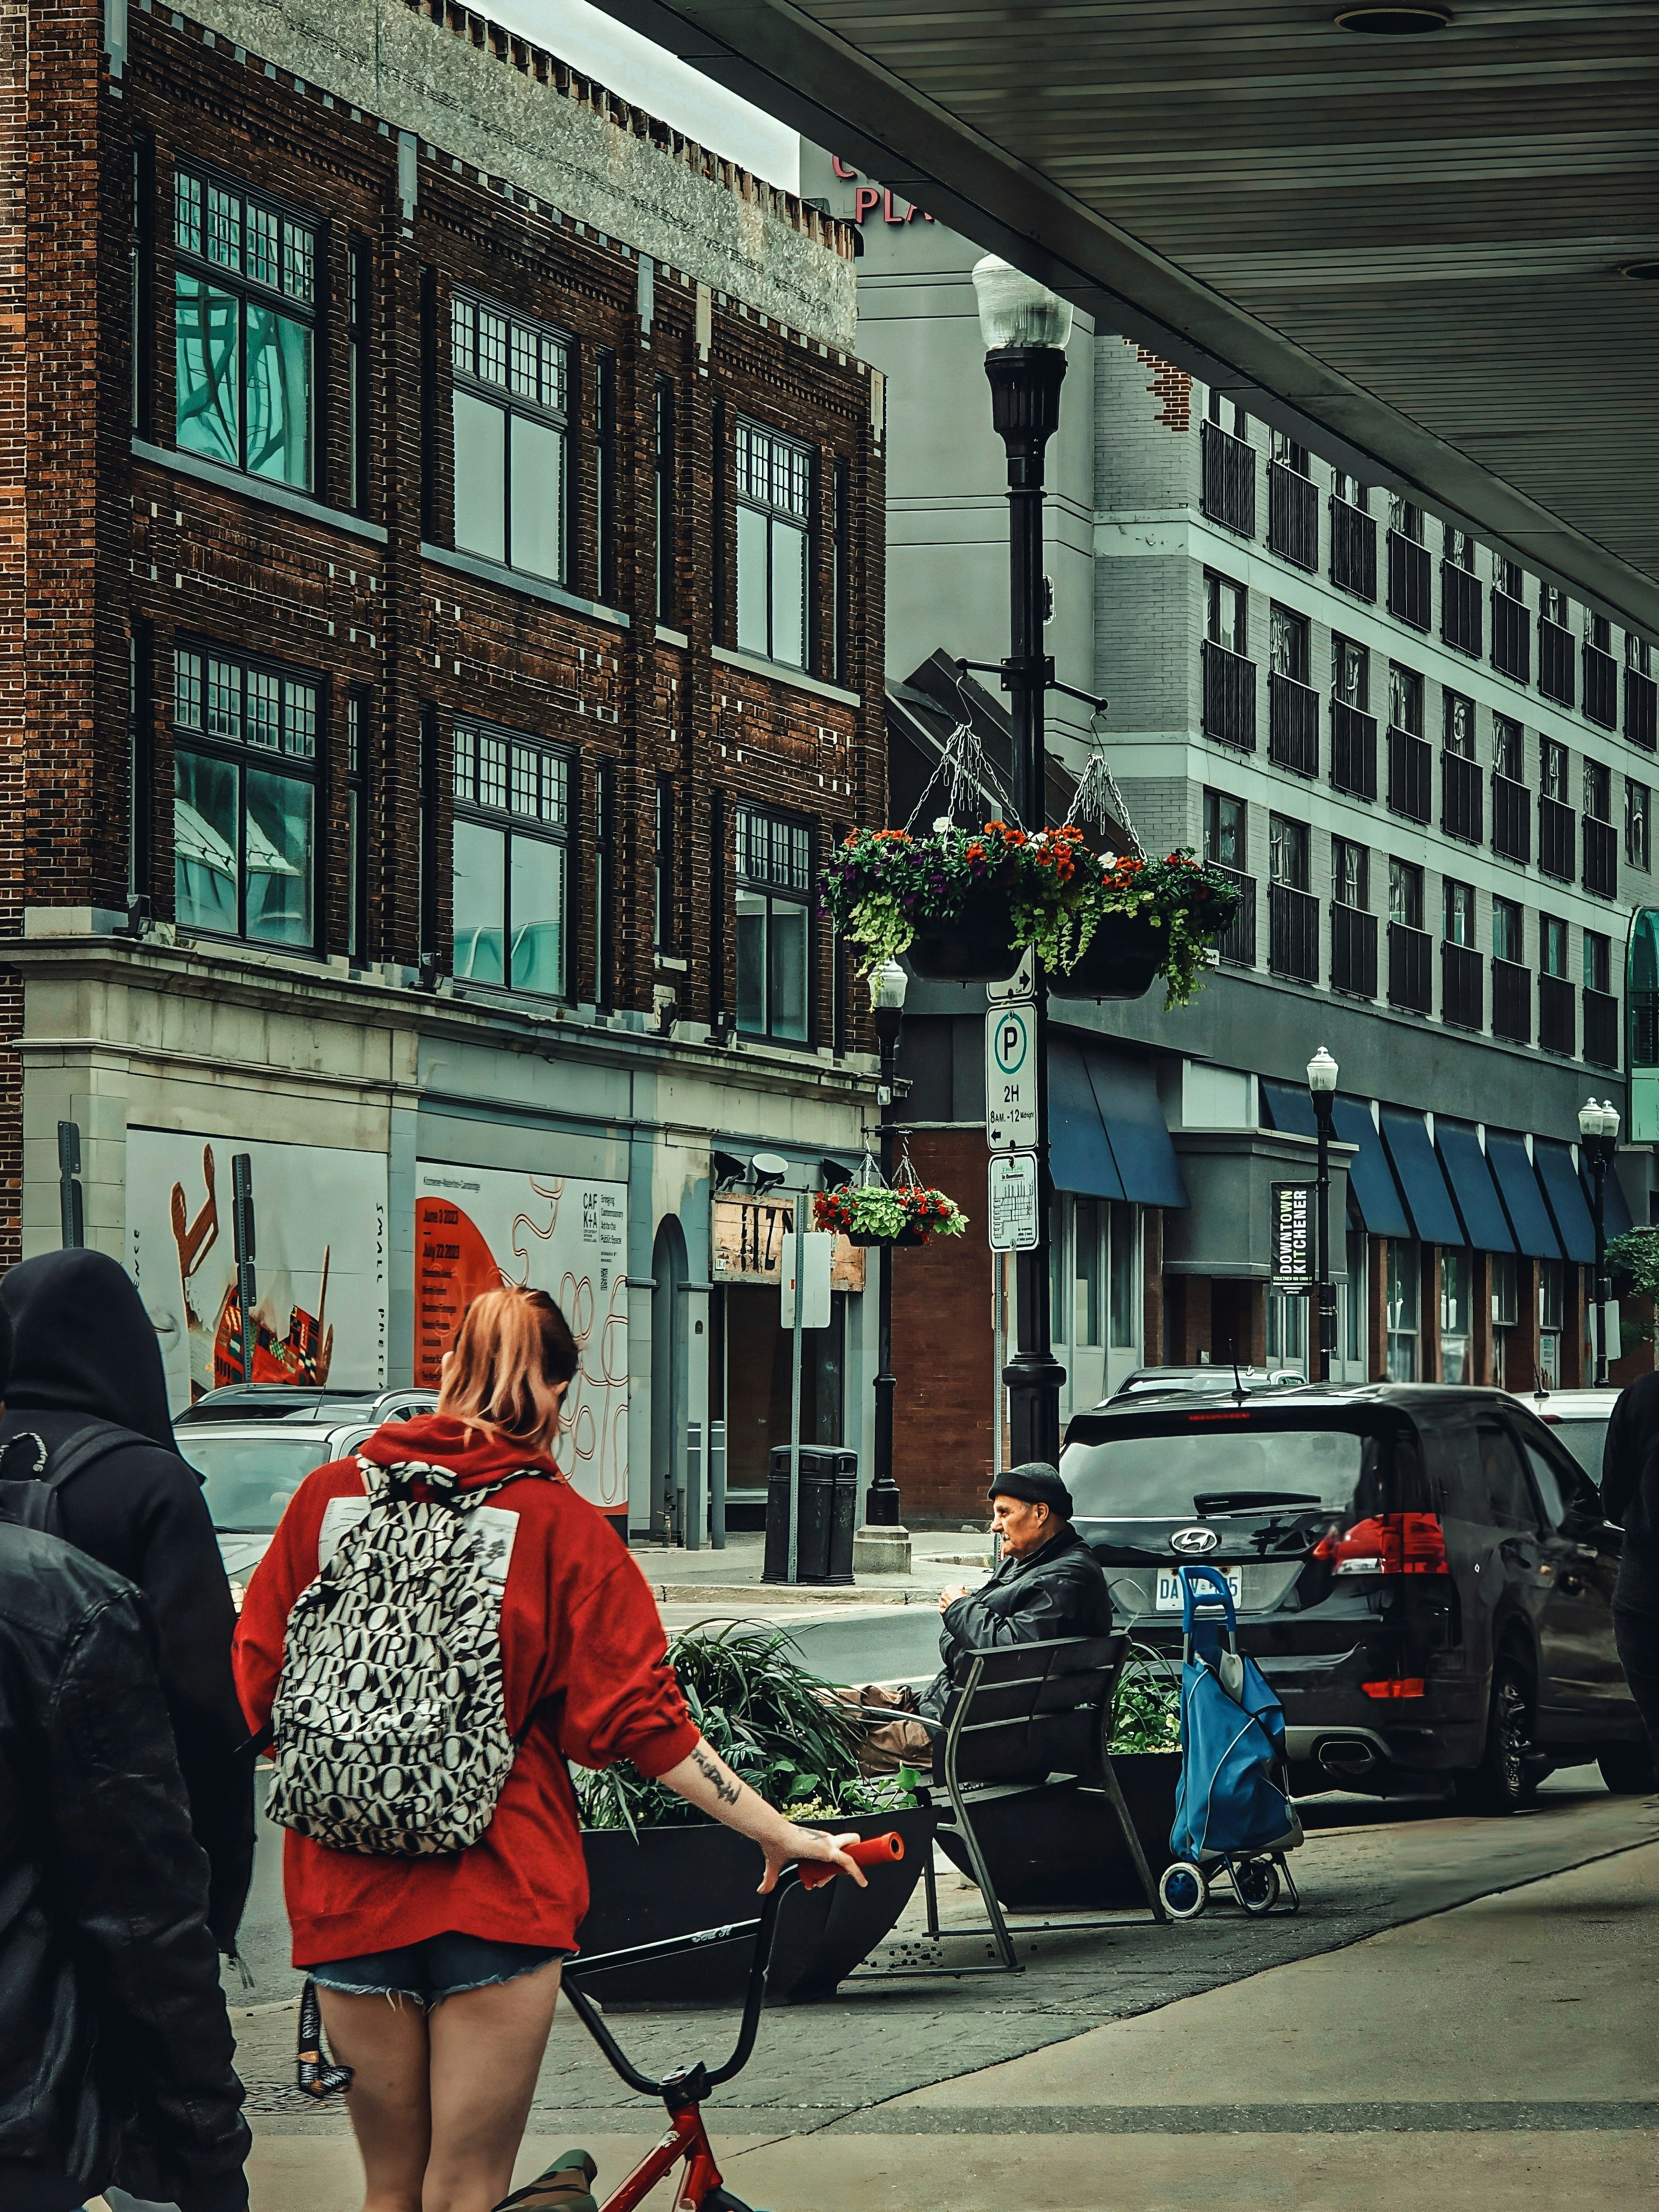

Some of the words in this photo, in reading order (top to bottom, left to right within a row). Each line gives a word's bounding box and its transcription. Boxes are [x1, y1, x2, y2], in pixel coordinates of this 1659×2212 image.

[1004, 1027, 1017, 1061] P
[1004, 1084, 1019, 1103] 2H
[583, 1192, 598, 1210] CAF
[1280, 1191, 1293, 1274] DOWNTOWN
[1293, 1190, 1307, 1274] KITCHENER
[1160, 1578, 1199, 1599] DAV
